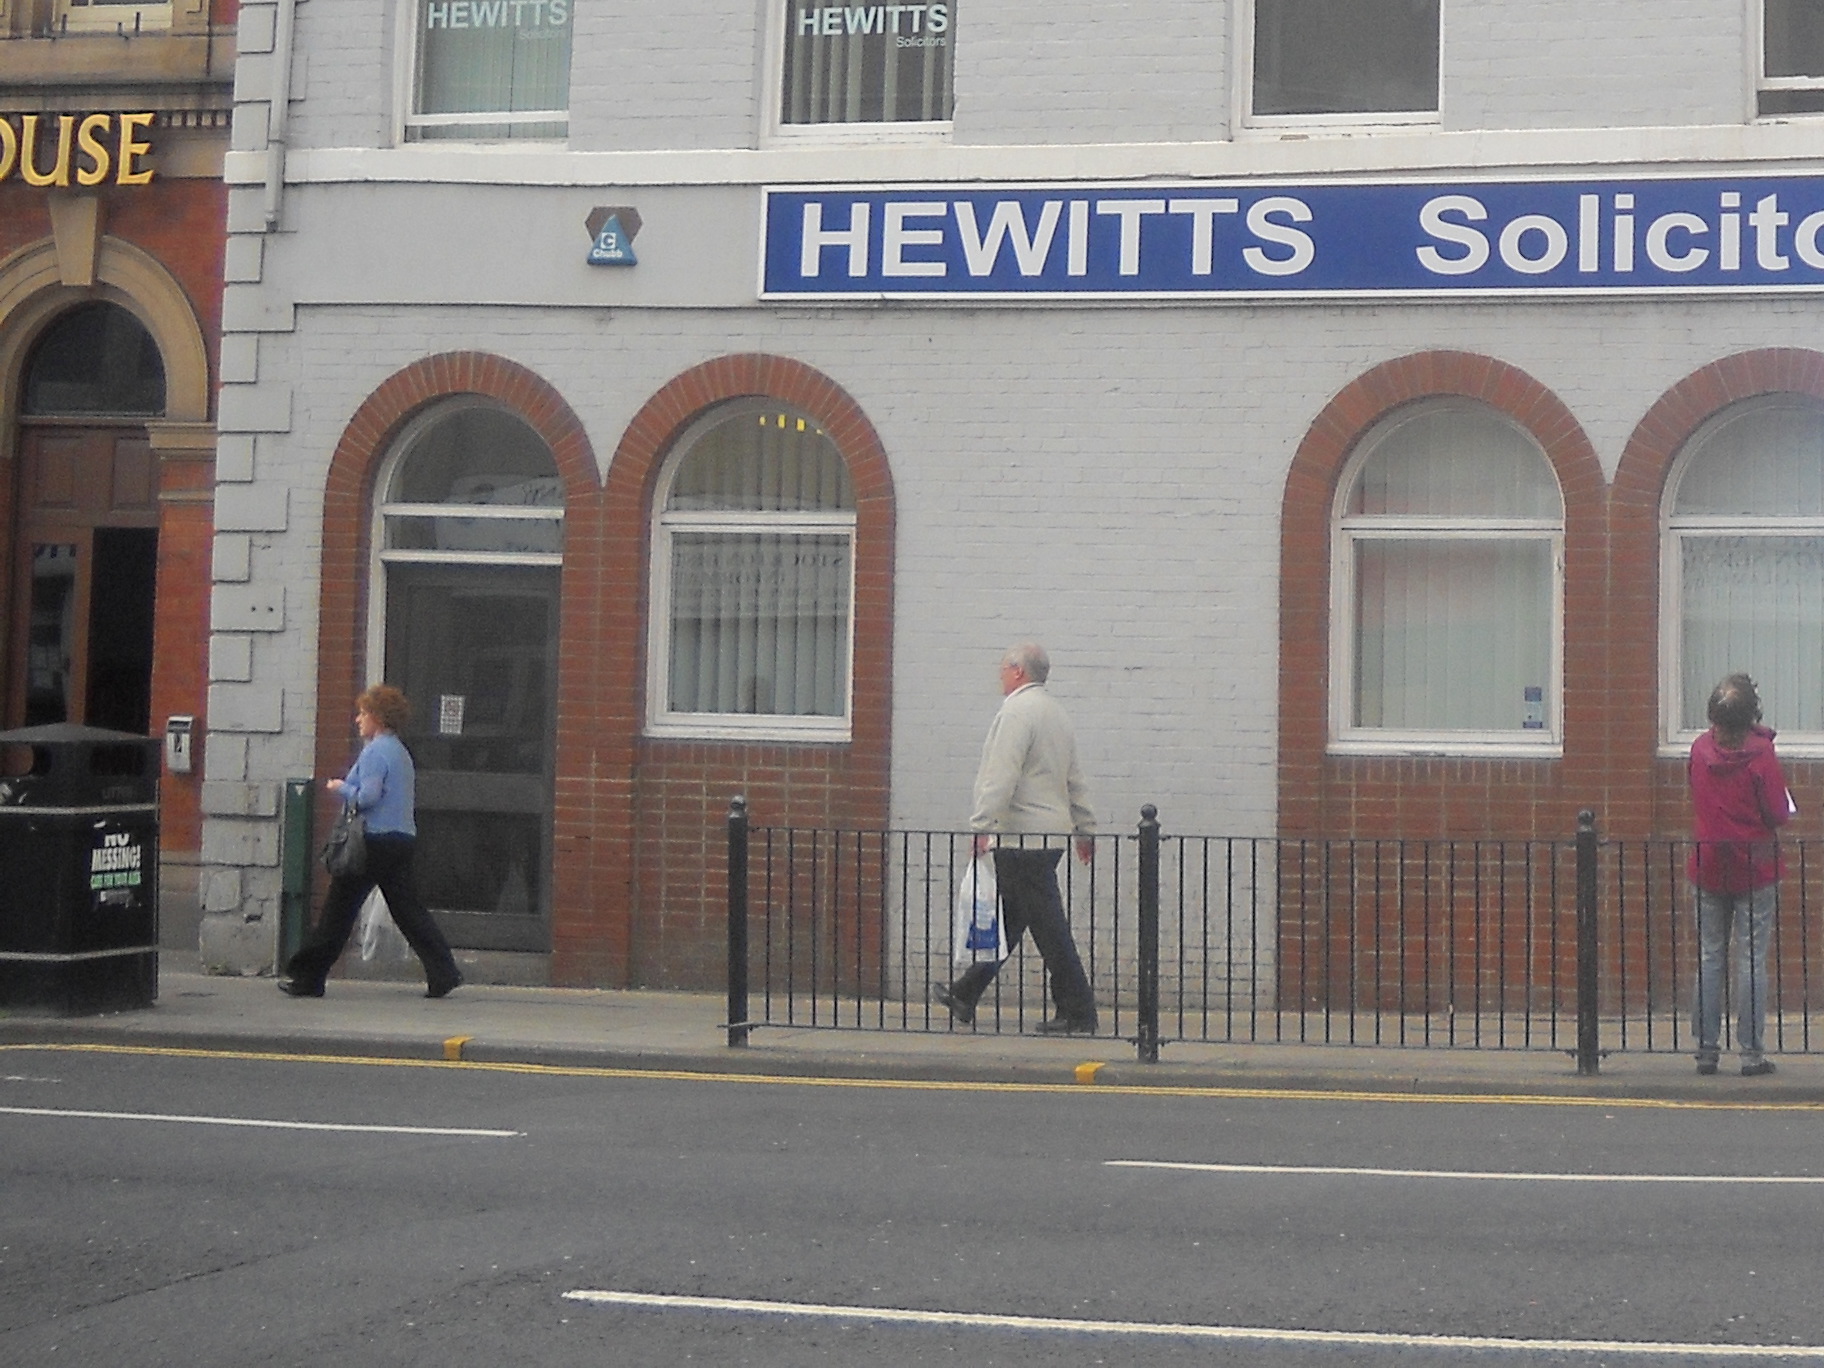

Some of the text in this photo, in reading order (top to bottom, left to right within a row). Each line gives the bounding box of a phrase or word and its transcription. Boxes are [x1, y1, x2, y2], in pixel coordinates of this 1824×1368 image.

[799, 3, 949, 37] HEWITTS
[895, 35, 946, 48] Solicitors
[0, 112, 155, 186] USE
[800, 196, 1316, 278] HEWITTS
